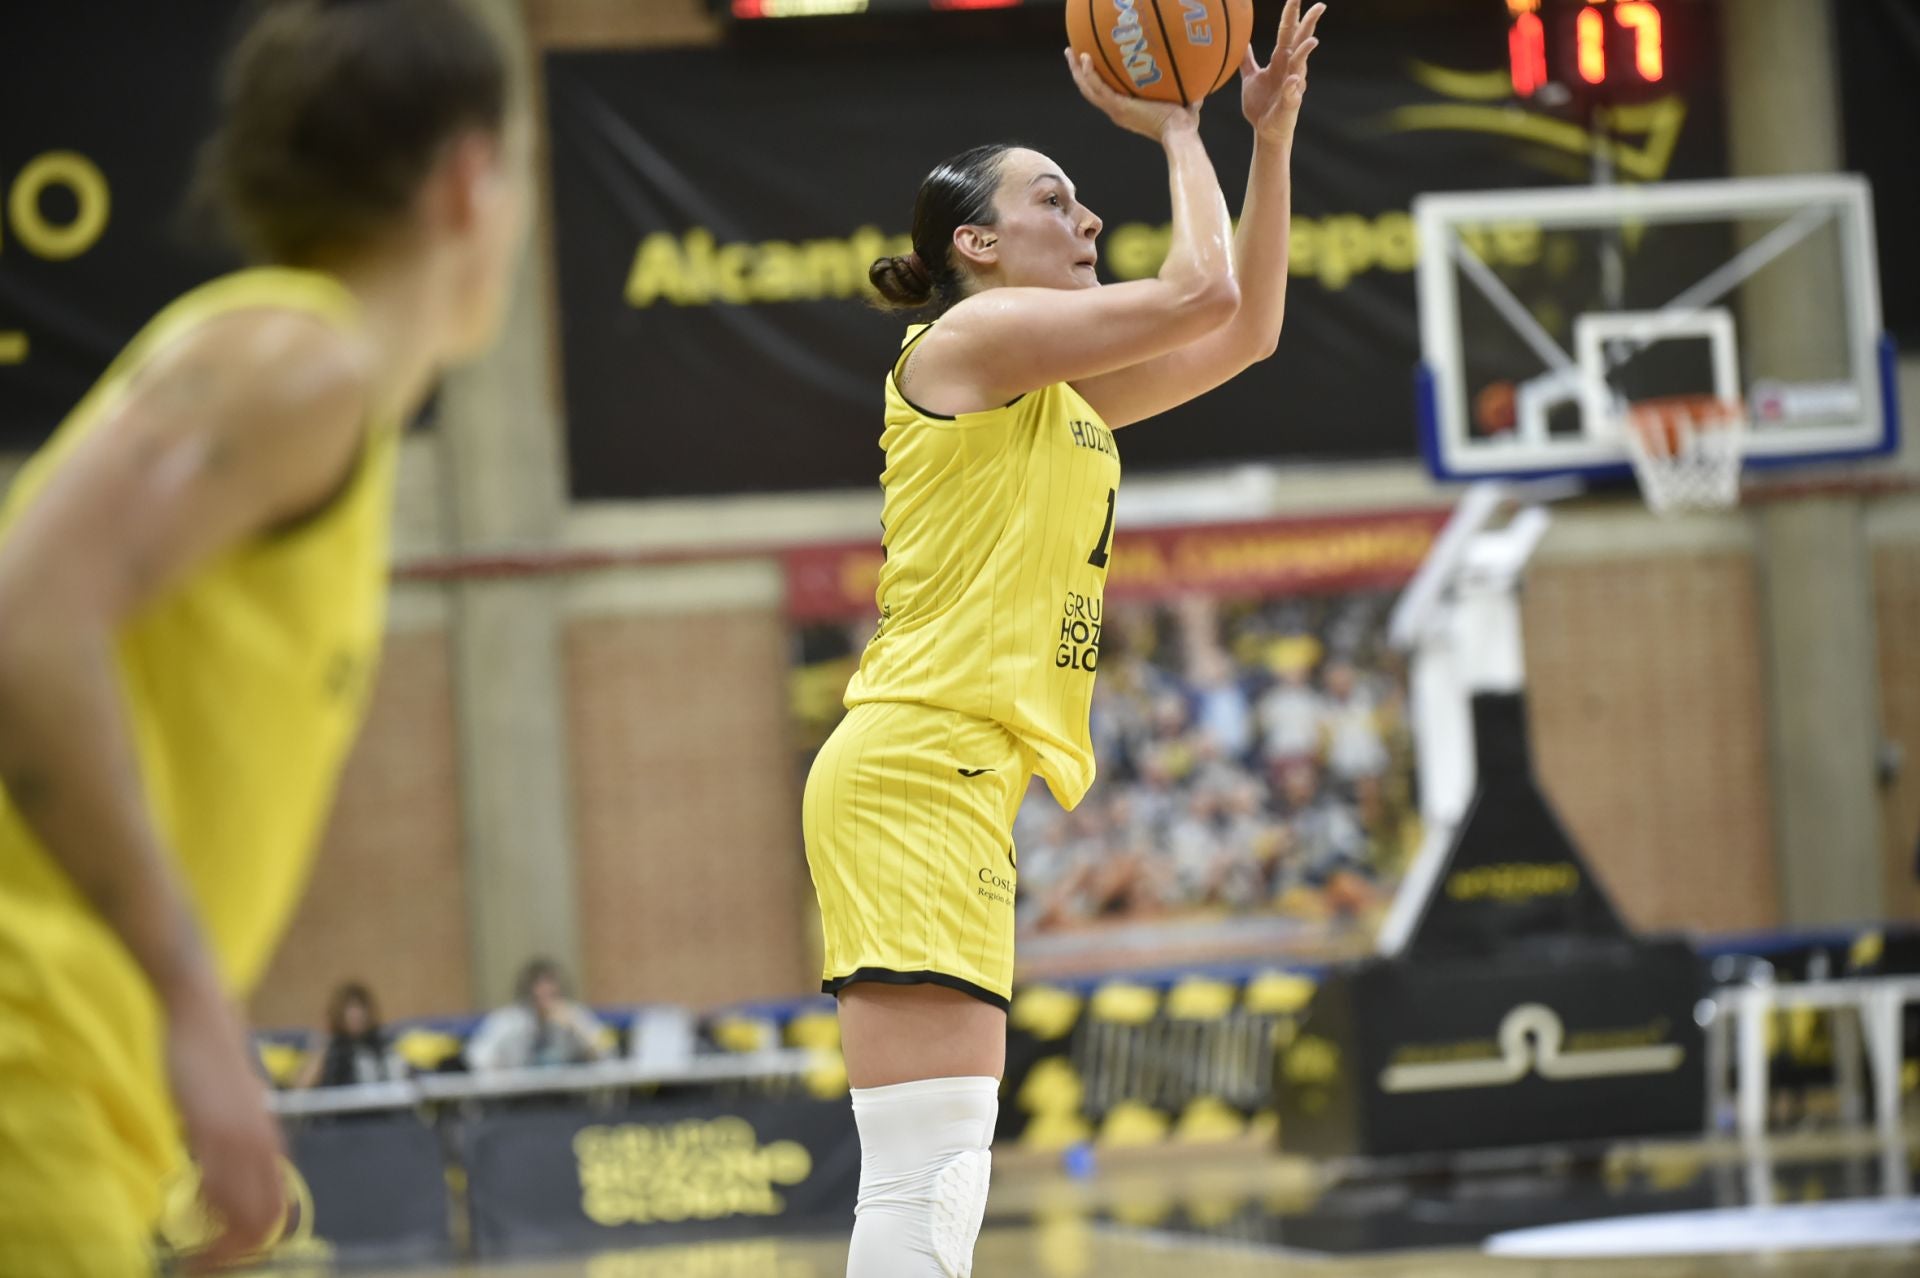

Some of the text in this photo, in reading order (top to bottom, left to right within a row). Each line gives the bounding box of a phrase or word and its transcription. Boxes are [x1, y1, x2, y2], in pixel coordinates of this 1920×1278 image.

[624, 224, 914, 308] Alcant
[1087, 487, 1116, 569] 1
[1064, 591, 1101, 621] GRU
[1055, 643, 1098, 672] GLO
